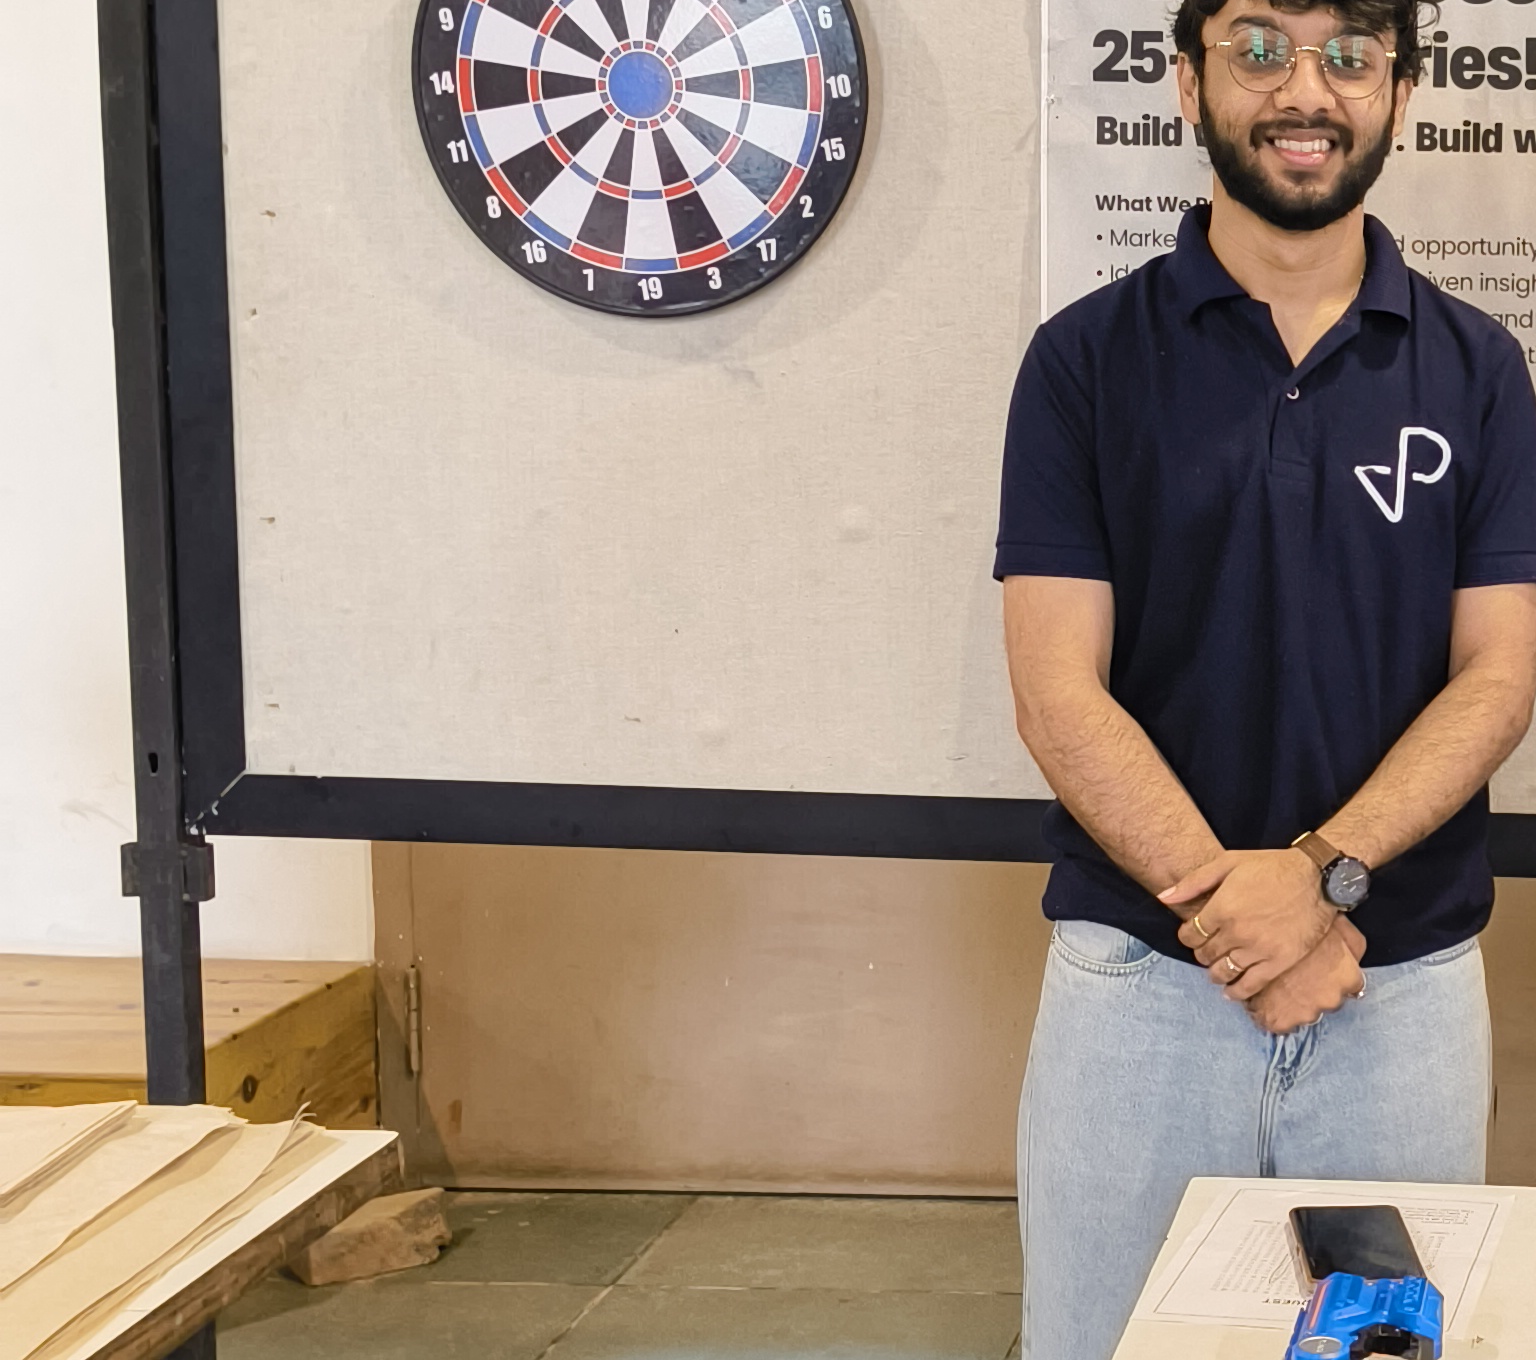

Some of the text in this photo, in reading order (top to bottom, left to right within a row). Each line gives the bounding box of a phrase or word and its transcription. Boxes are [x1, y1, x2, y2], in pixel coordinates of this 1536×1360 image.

[438, 7, 455, 32] 9
[818, 5, 833, 30] 6
[429, 70, 456, 96] 14
[826, 73, 852, 98] 10
[1096, 114, 1183, 147] Build
[1416, 120, 1503, 154] Build
[447, 139, 470, 164] 11
[820, 138, 846, 162] 15
[486, 195, 502, 219] 8
[799, 195, 815, 218] 2
[1095, 194, 1152, 211] What
[1157, 196, 1191, 213] We
[521, 240, 548, 265] 16
[756, 238, 778, 263] 17
[582, 268, 595, 292] 7
[637, 276, 664, 301] 19
[708, 267, 723, 290] 3
